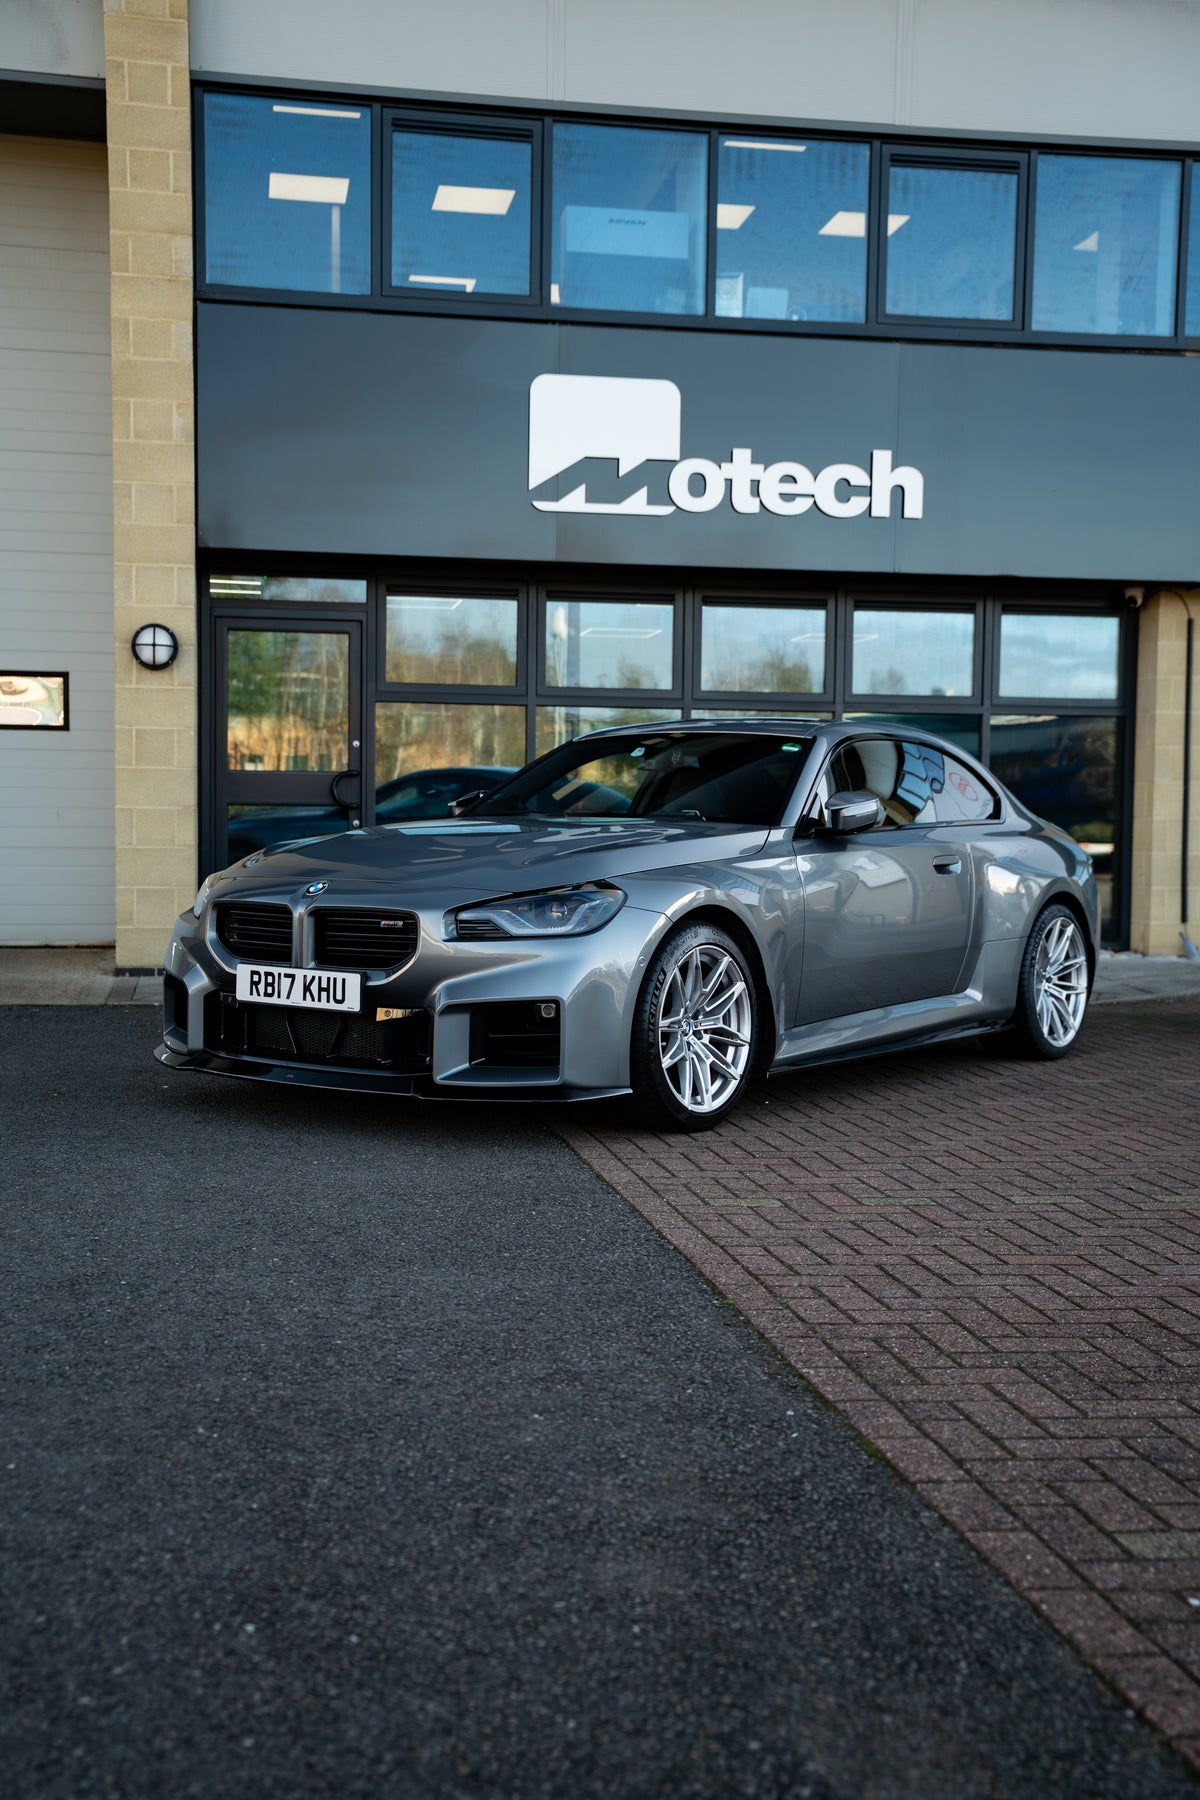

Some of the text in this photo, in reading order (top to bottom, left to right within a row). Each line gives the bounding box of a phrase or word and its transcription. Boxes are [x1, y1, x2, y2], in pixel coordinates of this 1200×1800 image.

[249, 970, 347, 1005] RB17 KHU
[648, 970, 666, 1043] MICHELIN
